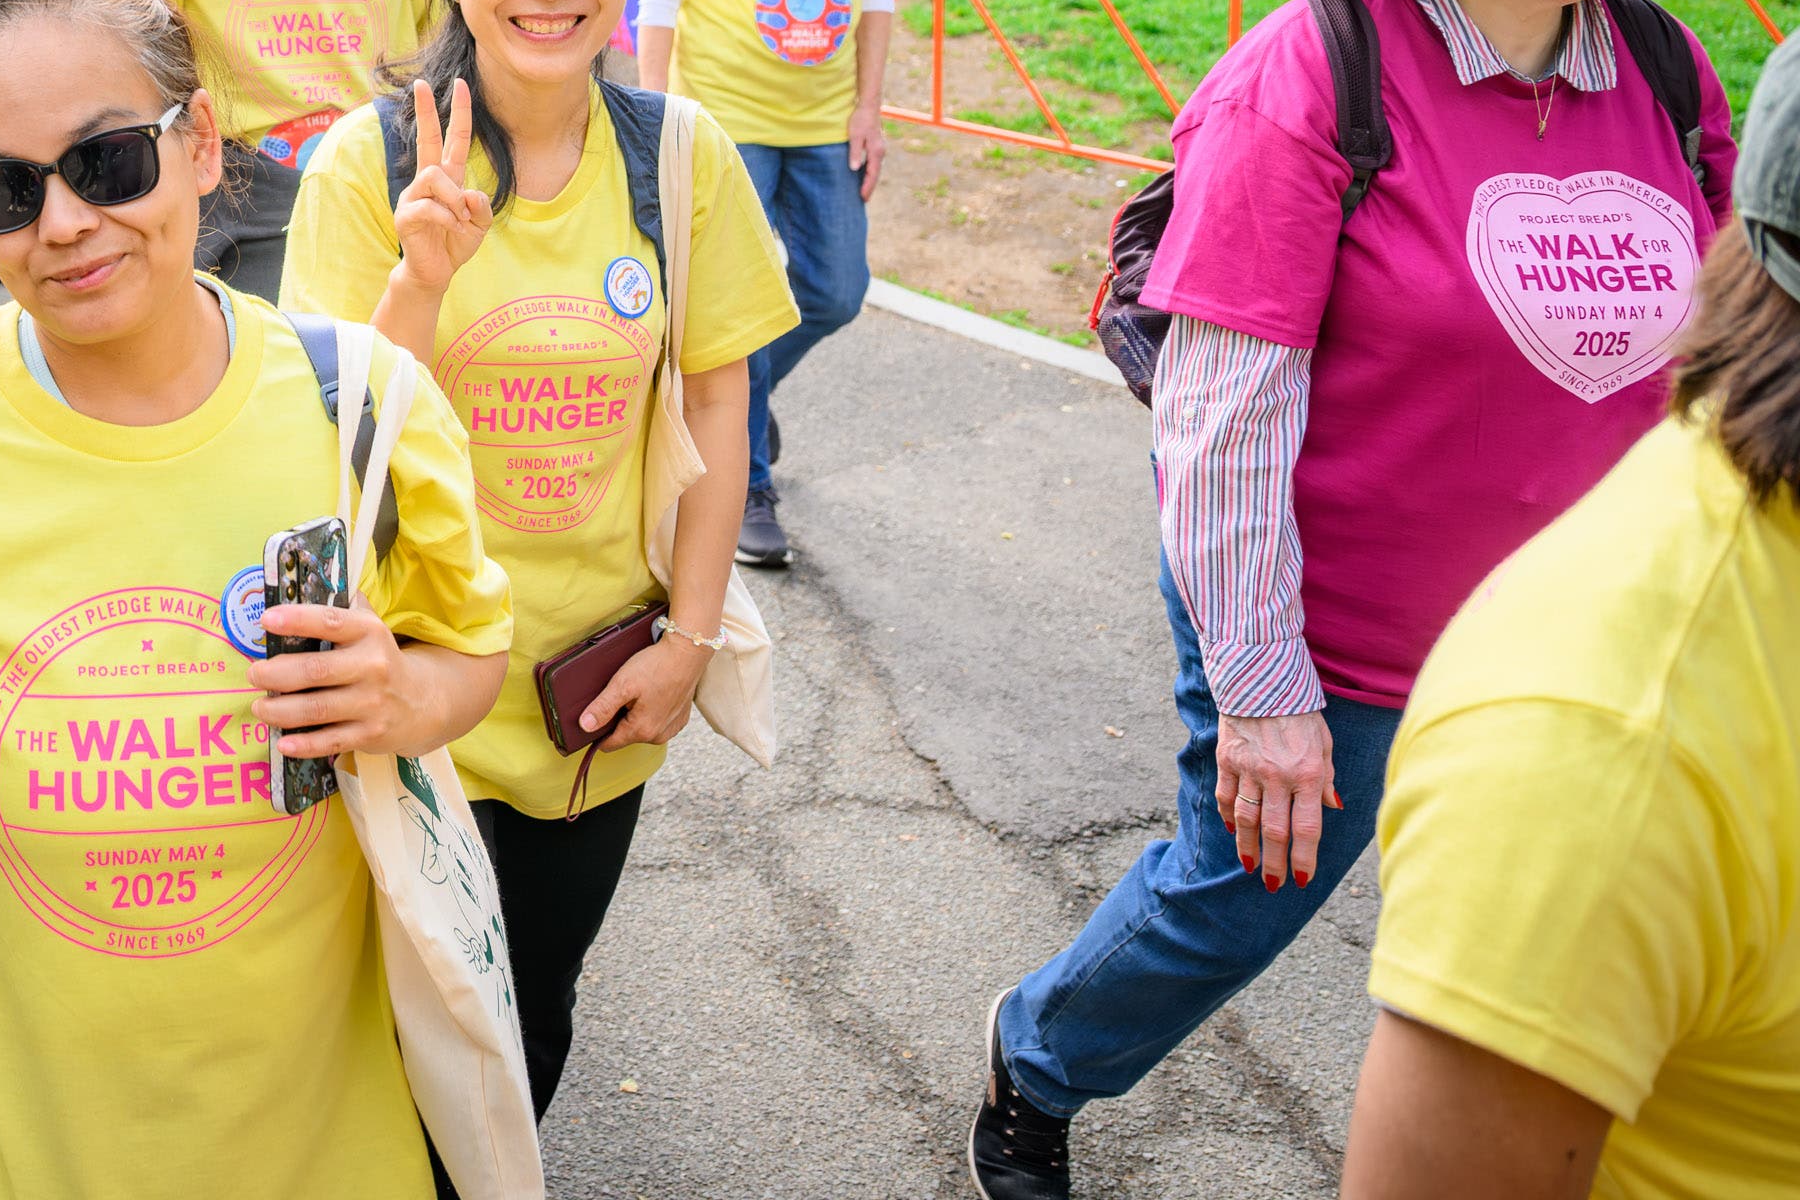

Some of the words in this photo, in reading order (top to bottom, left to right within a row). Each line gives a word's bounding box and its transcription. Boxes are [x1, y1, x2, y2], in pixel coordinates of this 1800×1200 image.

[272, 12, 345, 34] WALK
[257, 34, 362, 58] HUNGER
[304, 114, 331, 127] THIS
[1481, 178, 1512, 202] OLDEST
[1515, 177, 1561, 195] PLEDGE
[1565, 176, 1597, 194] WALK
[1601, 176, 1615, 186] IN
[1619, 177, 1672, 214] AMERICA
[1519, 214, 1575, 224] PROJECT
[1579, 212, 1633, 224] BREAD'S
[1499, 239, 1527, 255] THE
[1526, 233, 1643, 261] WALK
[1642, 239, 1673, 254] FOR
[1516, 263, 1677, 293] HUNGER
[1544, 304, 1607, 320] SUNDAY
[1614, 305, 1647, 320] MAY
[1654, 305, 1663, 319] 4
[452, 341, 472, 364] THE
[471, 311, 512, 343] OLDEST
[513, 300, 553, 319] PLEDGE
[556, 301, 590, 316] WALK
[593, 303, 608, 319] IN
[610, 310, 651, 354] AMERICA
[1573, 330, 1631, 357] 2025
[507, 342, 558, 354] PROJECT
[561, 339, 608, 352] BREAD'S
[463, 382, 493, 398] THE
[499, 373, 611, 403] WALK
[613, 374, 640, 391] FOR
[1558, 370, 1589, 394] SINCE
[1598, 374, 1624, 394] 1969
[471, 398, 628, 434] HUNGER
[506, 454, 559, 471] SUNDAY
[561, 452, 585, 468] MAY
[586, 450, 595, 464] 4
[522, 473, 578, 500] 2025
[516, 514, 552, 529] SINCE
[556, 509, 582, 527] 1969
[0, 660, 29, 696] THE
[24, 614, 82, 666] OLDEST
[86, 596, 153, 625] PLEDGE
[159, 596, 208, 622] WALK
[77, 662, 150, 679] PROJECT
[156, 660, 227, 677] BREAD'S
[15, 728, 59, 753] THE
[66, 713, 237, 763] WALK
[241, 722, 270, 746] FO
[27, 761, 273, 814] HUNGER
[84, 848, 163, 868] SUNDAY
[167, 845, 208, 865] MAY
[213, 842, 226, 860] 4
[111, 870, 198, 910] 2025
[106, 931, 160, 950] SINCE
[167, 926, 207, 949] 1969
